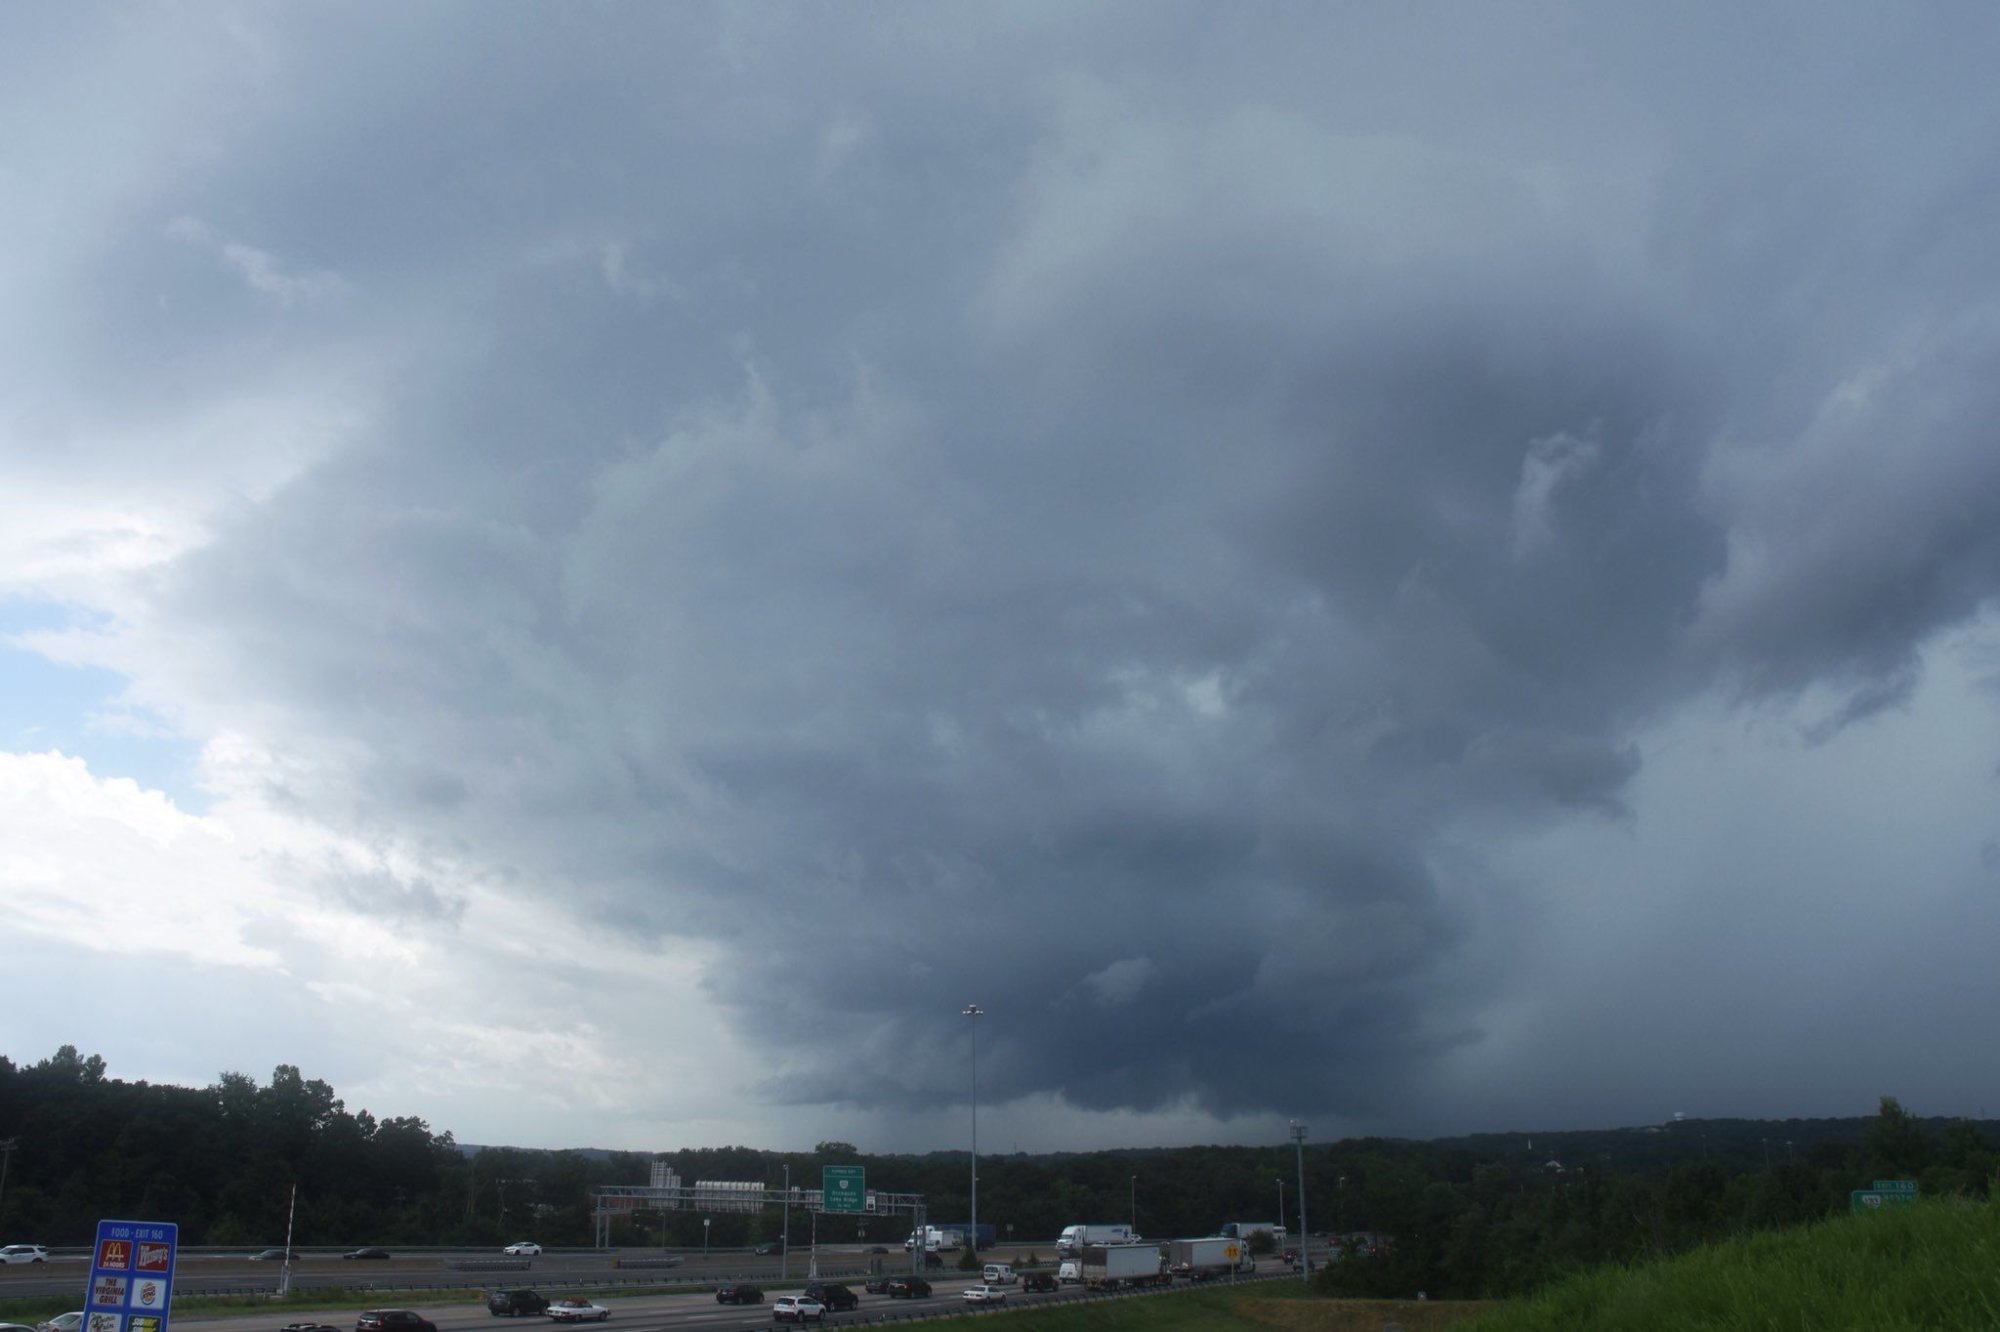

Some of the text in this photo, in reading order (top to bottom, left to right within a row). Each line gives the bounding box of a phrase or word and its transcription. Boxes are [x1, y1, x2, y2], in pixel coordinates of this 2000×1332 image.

[111, 1228, 129, 1238] FOOD
[135, 1228, 150, 1239] EXIT
[151, 1230, 163, 1239] 160
[139, 1245, 168, 1266] Wendy's
[105, 1278, 117, 1286] THE
[95, 1286, 125, 1296] VIRGINIA
[99, 1294, 118, 1304] GRILL
